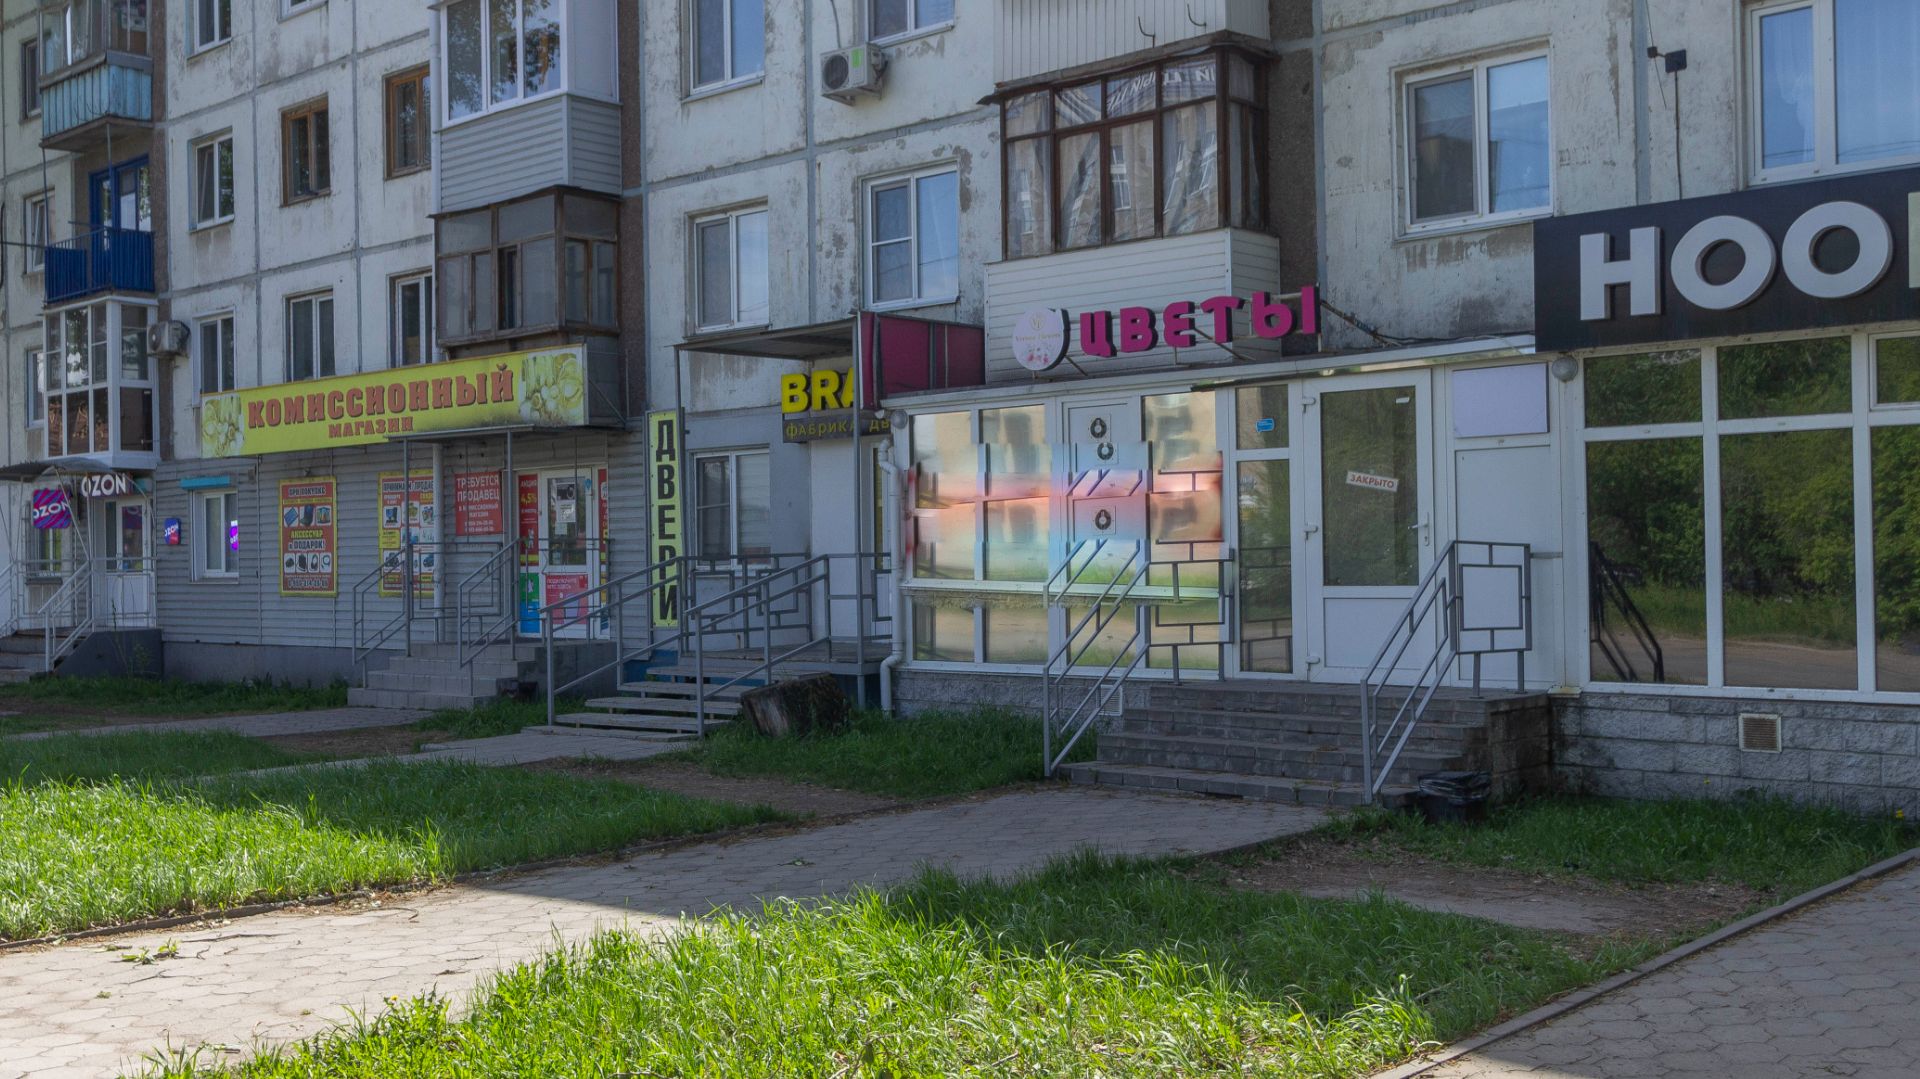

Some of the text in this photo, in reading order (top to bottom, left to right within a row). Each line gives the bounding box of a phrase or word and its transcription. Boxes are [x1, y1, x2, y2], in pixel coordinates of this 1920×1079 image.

[1580, 192, 1920, 321] HOO
[1080, 286, 1318, 357] ЦВЕТЫ
[248, 363, 514, 428] КОМИССИОННЫЙ
[328, 416, 414, 438] МАГАЗИН
[81, 474, 127, 498] OZON
[457, 475, 499, 489] ТРЕБУЕТСЯ
[1350, 475, 1395, 489] ЗАКРЫТО
[457, 488, 499, 503] ПРОДАВЕЦ
[655, 420, 678, 620] ДВЕРИ
